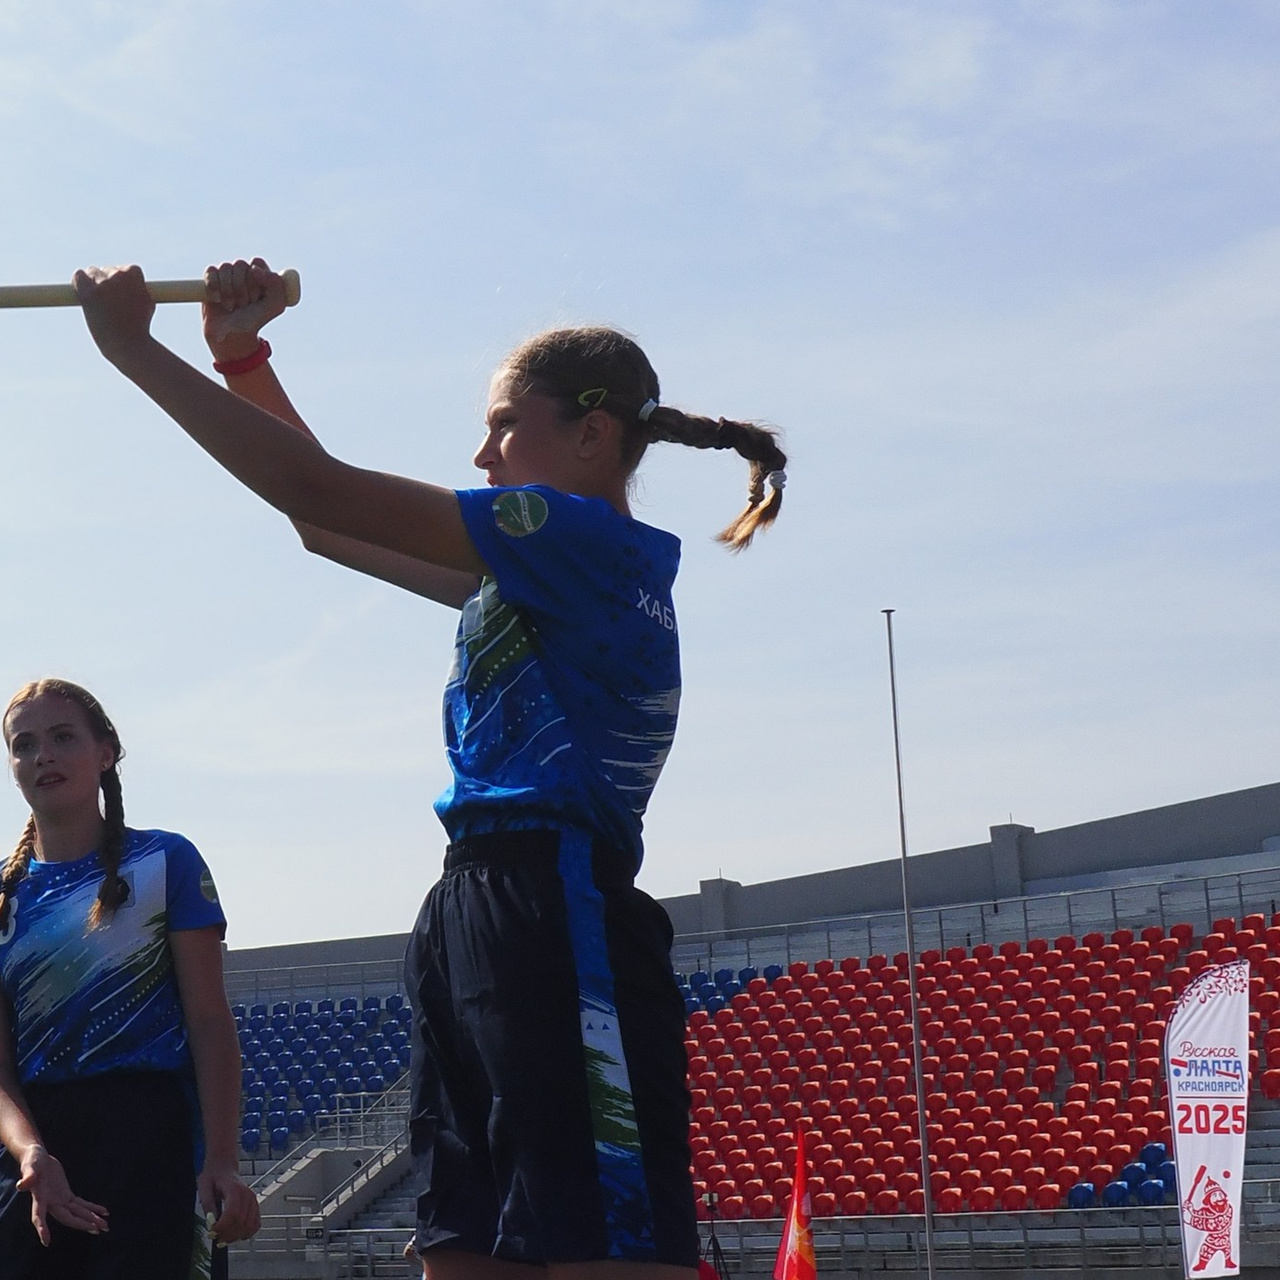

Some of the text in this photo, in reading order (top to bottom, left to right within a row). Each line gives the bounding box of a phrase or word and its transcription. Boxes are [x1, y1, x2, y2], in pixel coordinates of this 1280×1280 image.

[1178, 1041, 1239, 1058] Русская
[1186, 1060, 1244, 1081] ЛАПТА
[1178, 1081, 1244, 1093] КРАСНОЯРСК
[1177, 1104, 1246, 1134] 2025
